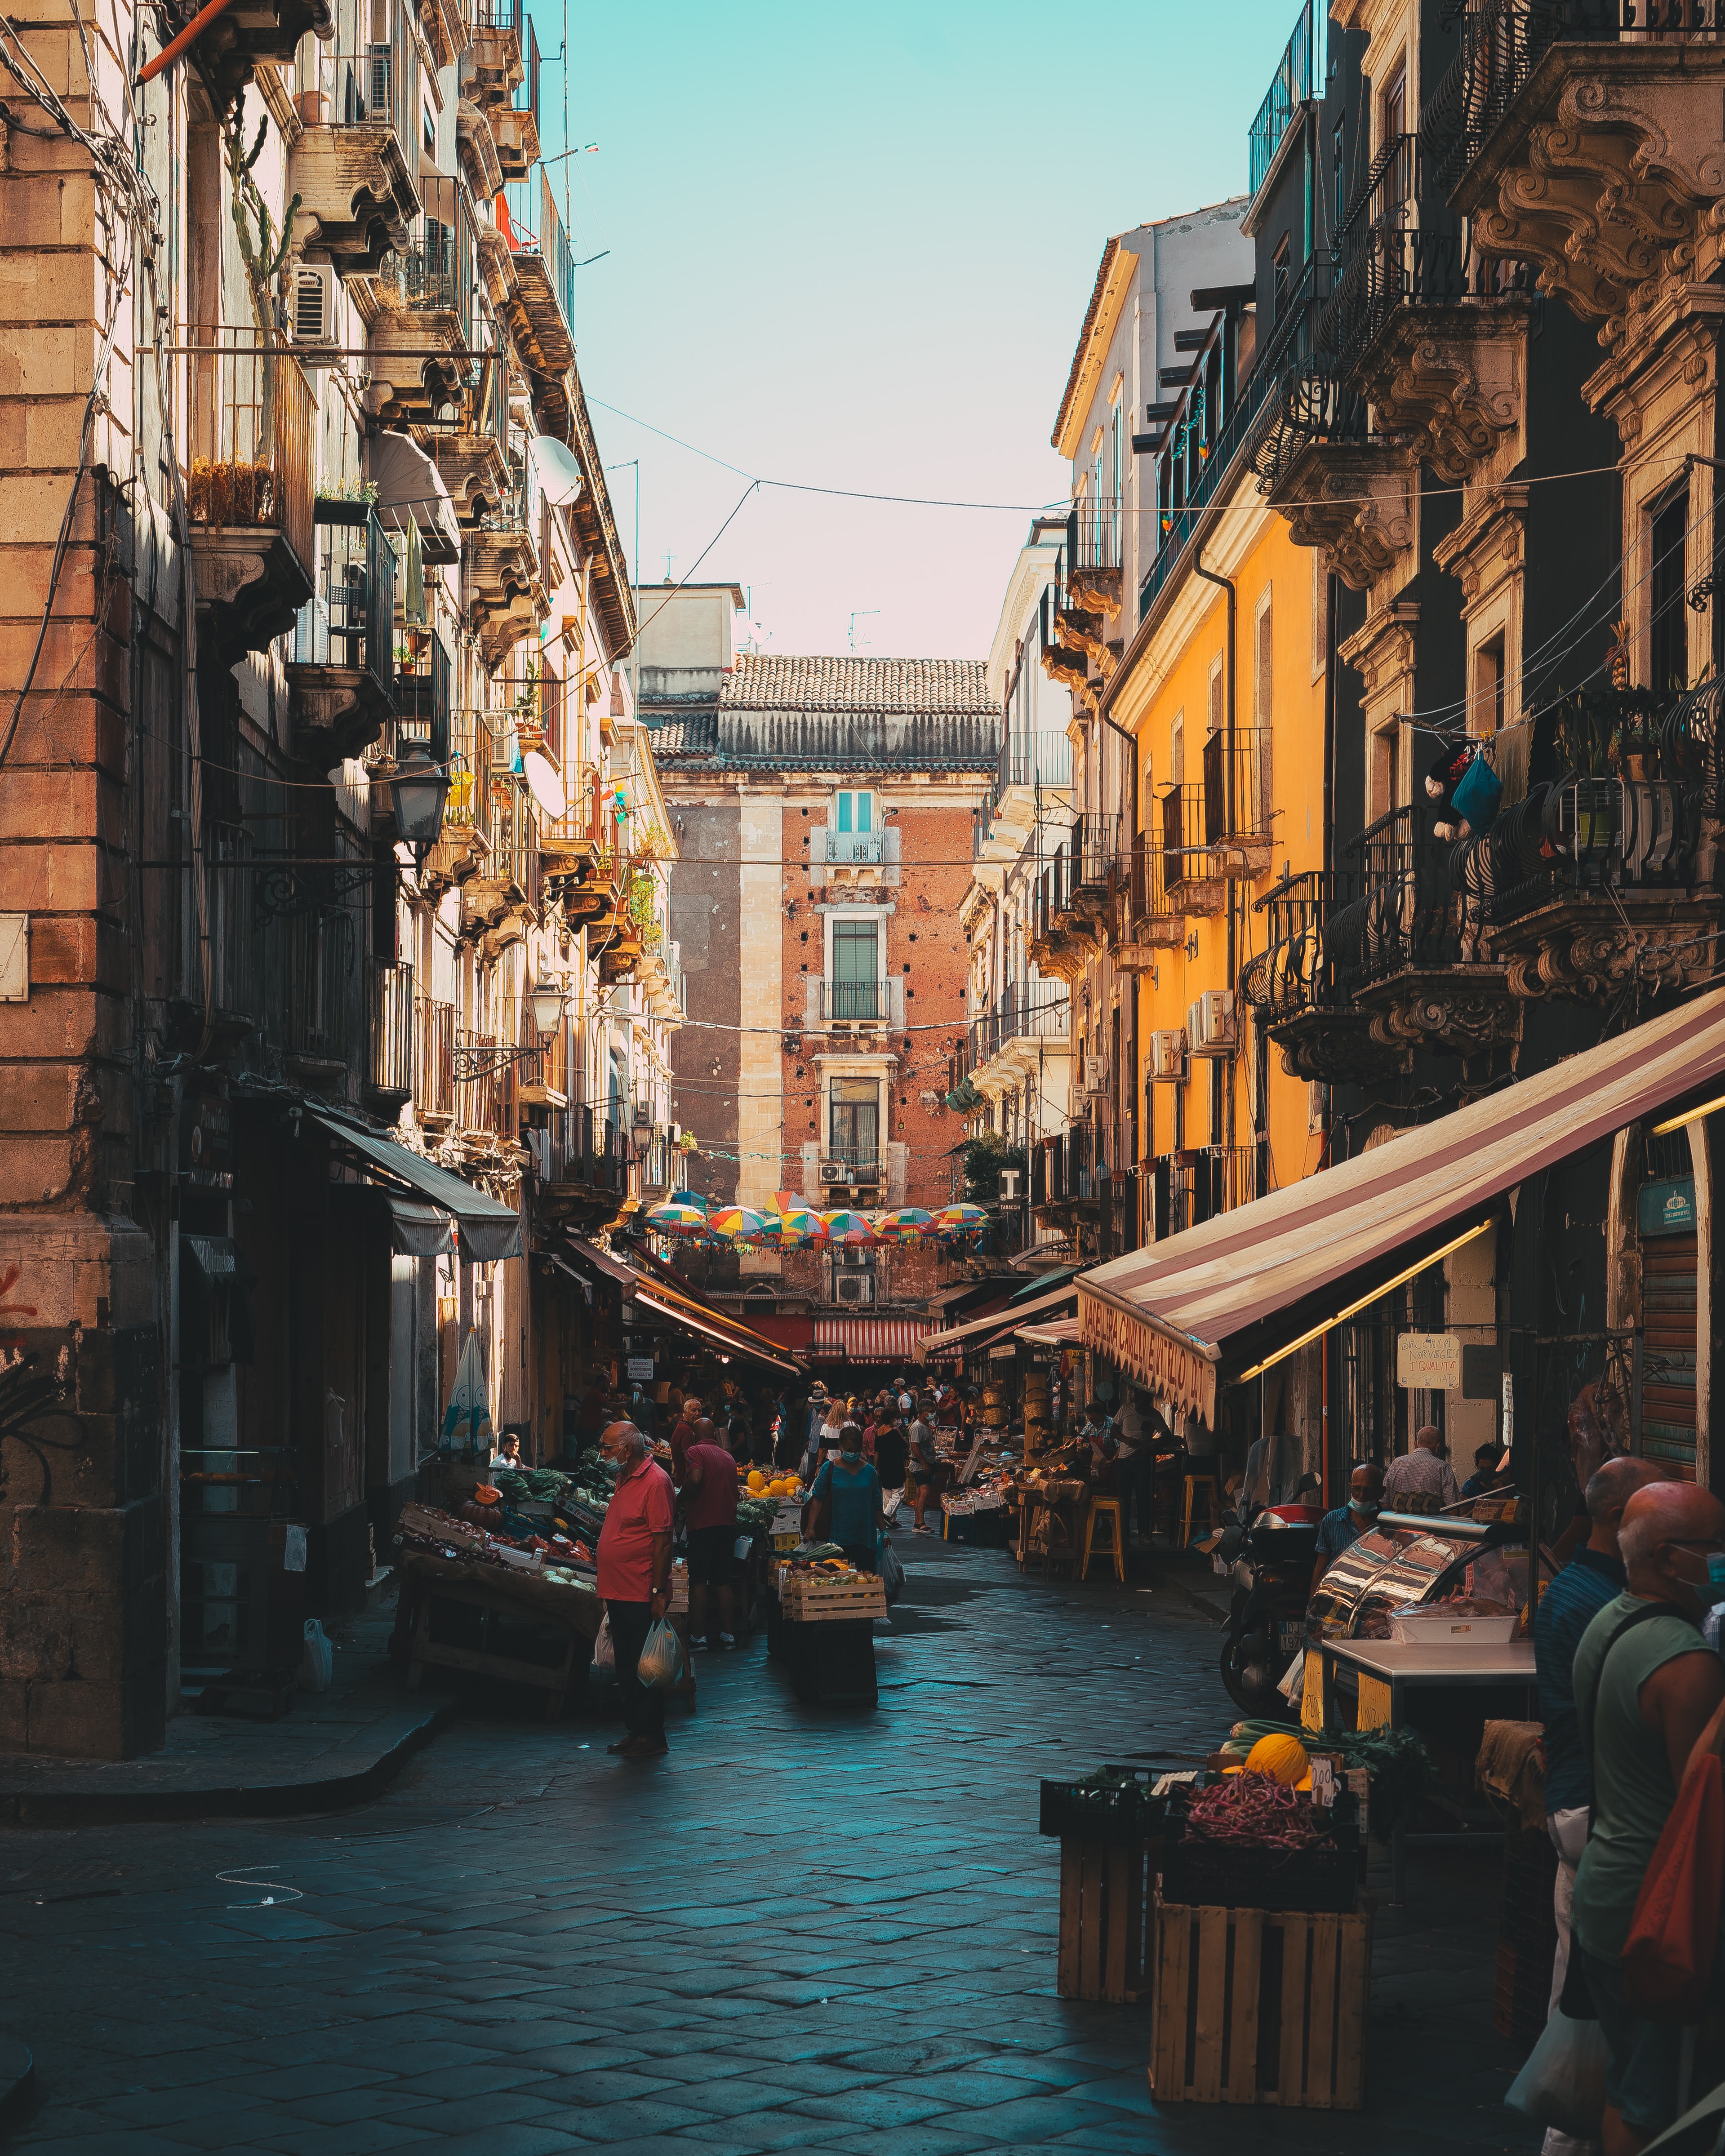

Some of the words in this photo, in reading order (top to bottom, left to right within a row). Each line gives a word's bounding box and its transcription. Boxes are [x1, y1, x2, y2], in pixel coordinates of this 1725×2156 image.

[201, 1104, 230, 1136] Panificio
[1002, 1171, 1019, 1199] T
[1148, 1332, 1155, 1371] E
[1288, 1623, 1299, 1633] DJ
